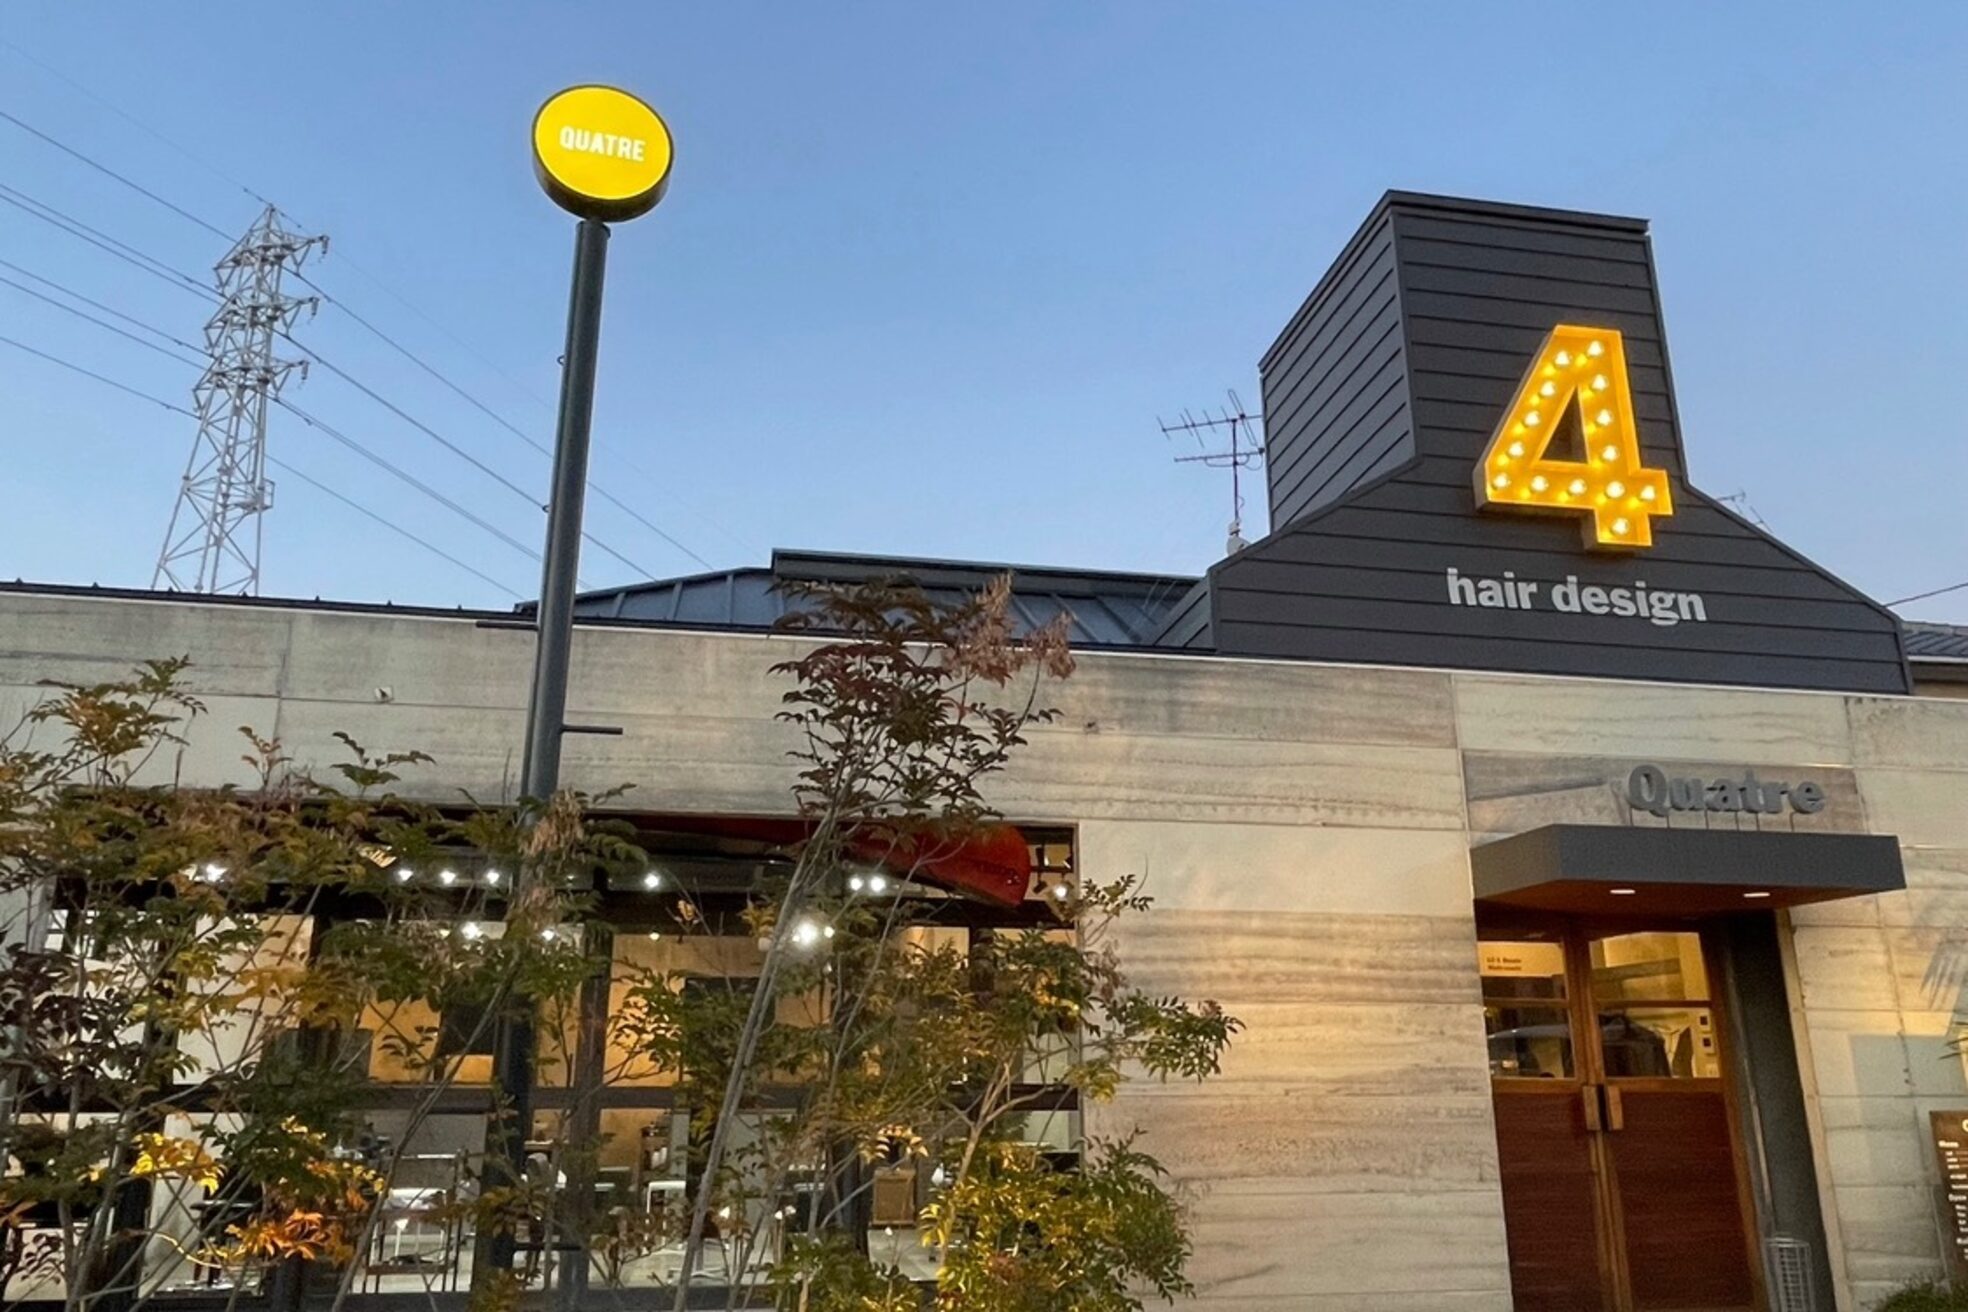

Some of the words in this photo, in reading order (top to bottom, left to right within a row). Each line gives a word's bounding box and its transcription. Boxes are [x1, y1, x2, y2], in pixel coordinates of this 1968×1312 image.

[560, 125, 646, 162] QUATRE
[1475, 324, 1673, 549] 4
[1446, 567, 1537, 609] hair
[1551, 575, 1706, 626] design
[1627, 764, 1825, 817] Quatre
